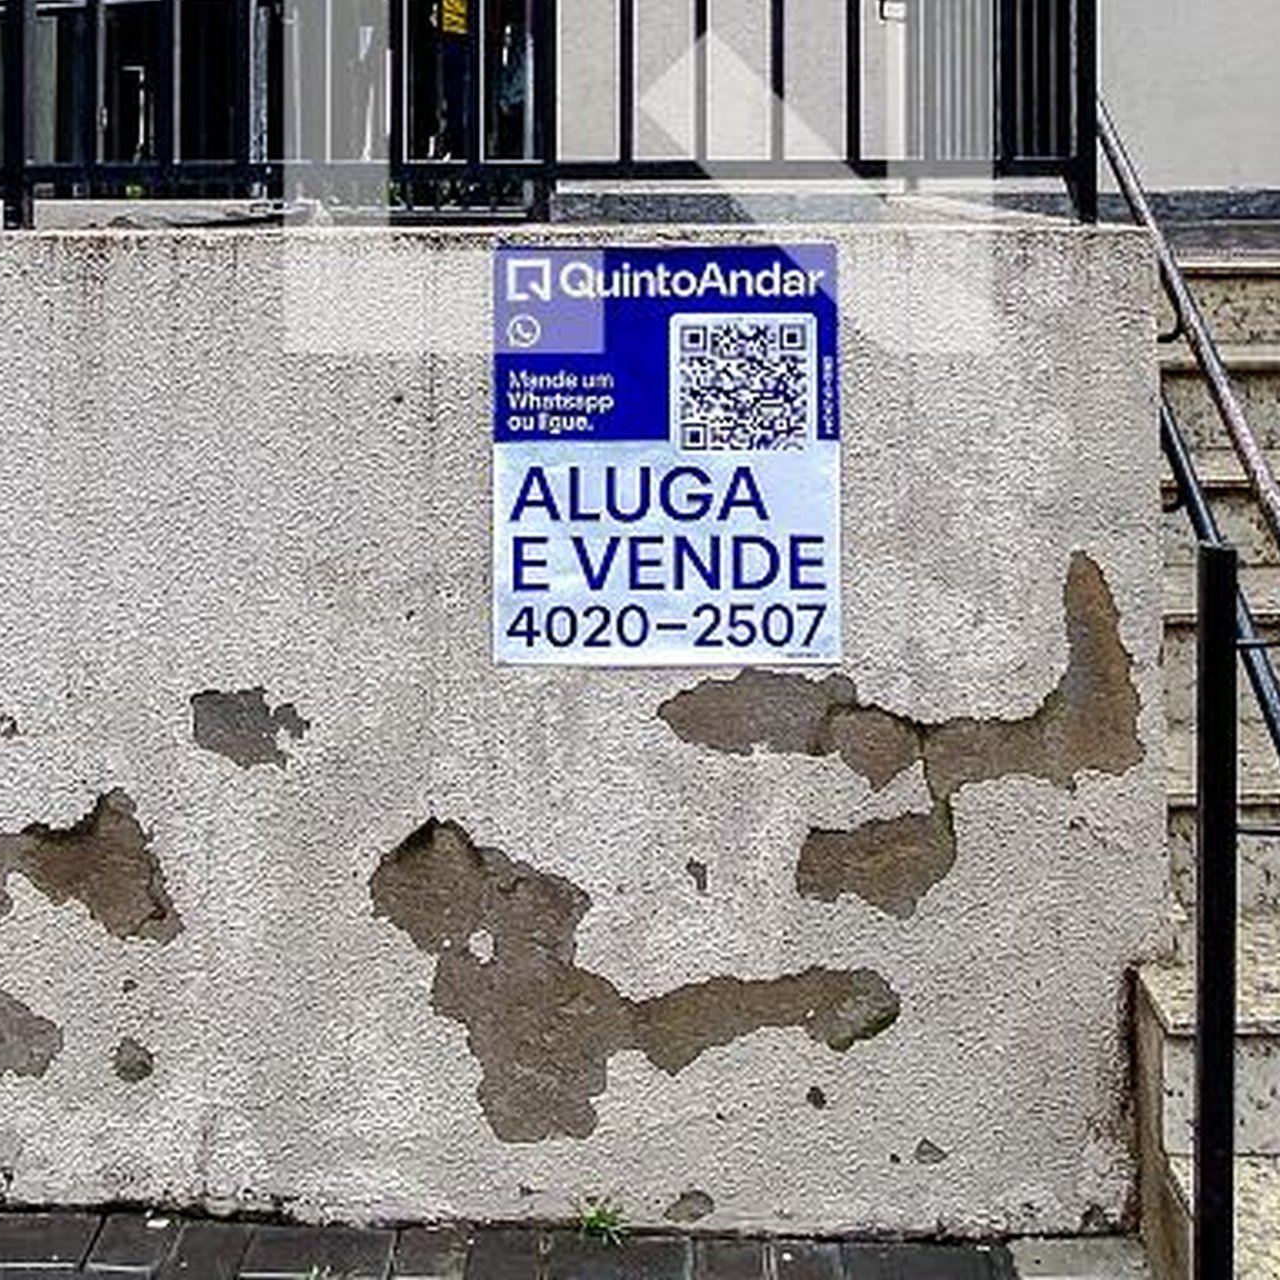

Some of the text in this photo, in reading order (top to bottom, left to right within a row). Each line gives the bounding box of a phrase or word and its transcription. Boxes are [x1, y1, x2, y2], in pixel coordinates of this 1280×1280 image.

[560, 261, 824, 299] QuintoAndar
[507, 415, 535, 431] ou
[509, 466, 769, 521] ALUGA
[512, 535, 826, 591] E VENDE
[506, 603, 827, 648] 4020-2507
